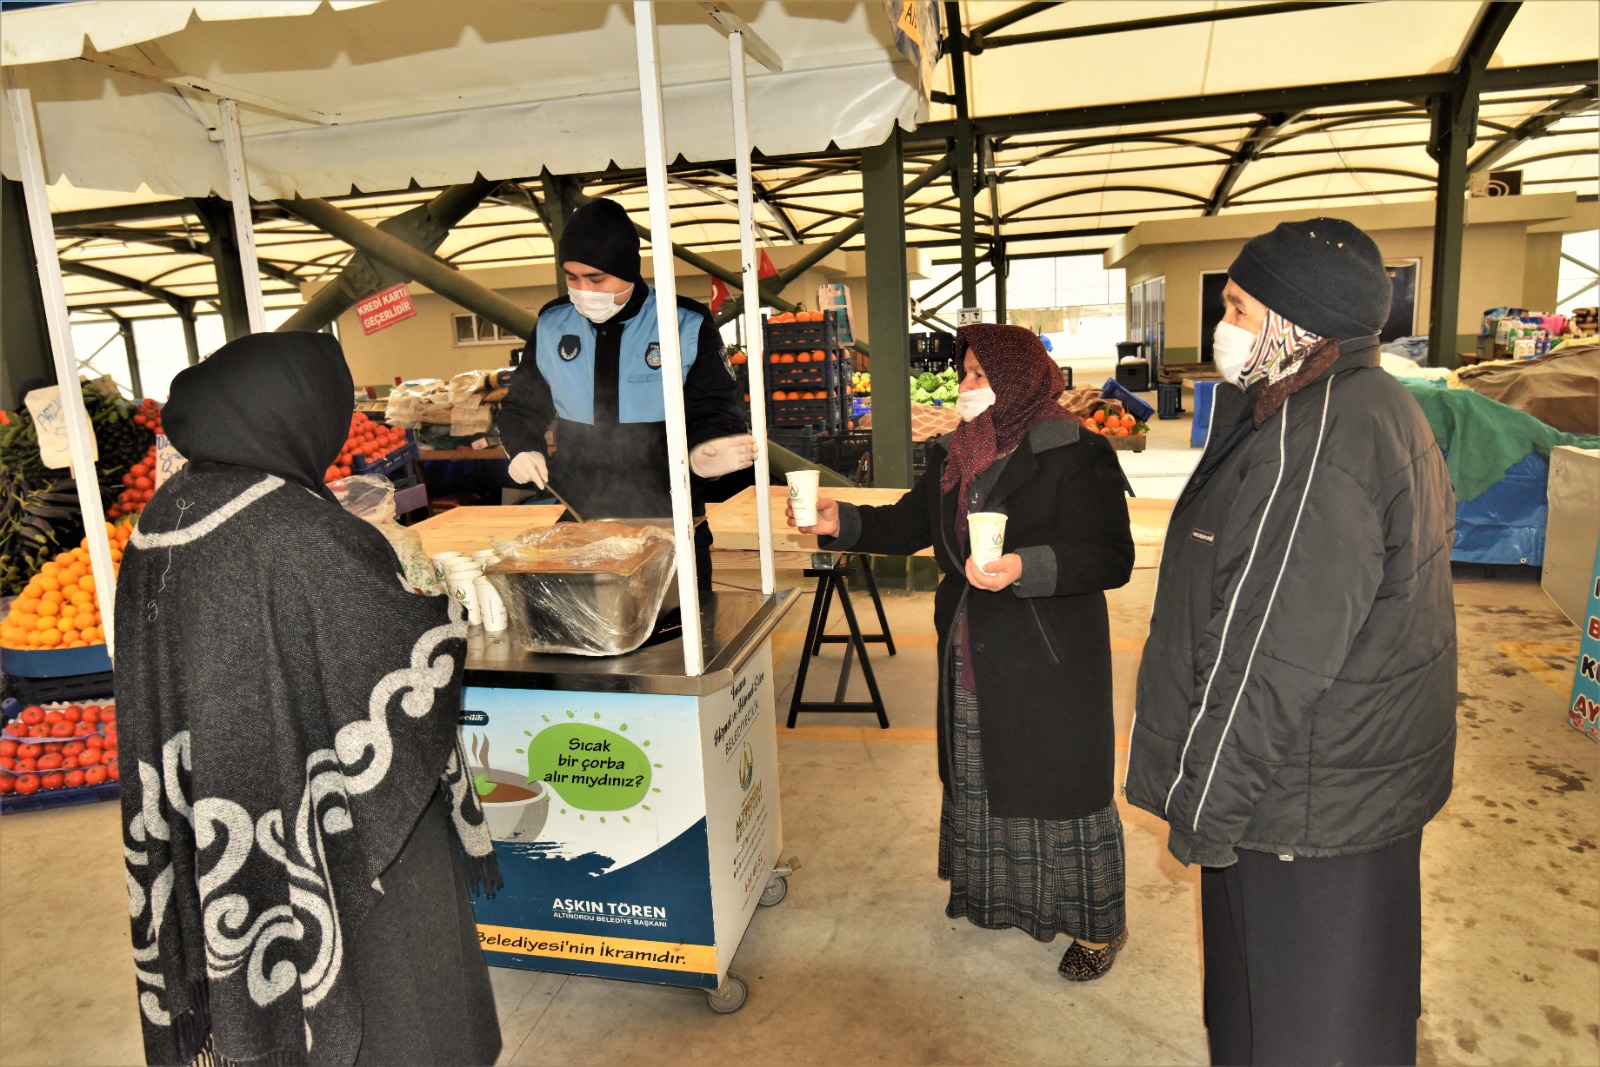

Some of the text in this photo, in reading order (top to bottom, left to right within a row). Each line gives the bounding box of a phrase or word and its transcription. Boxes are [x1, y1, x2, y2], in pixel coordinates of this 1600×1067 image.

[357, 287, 408, 316] KREDİ KARTI
[363, 301, 412, 328] GEÇERLİDİR
[569, 738, 611, 752] Sıcak
[558, 754, 625, 771] bir çorba
[543, 770, 644, 788] alır mıydınız?
[552, 898, 666, 918] AŞKIN TÖREN
[553, 912, 667, 928] ALTINORDU BELEDİYE BAŞKANI
[476, 931, 686, 965] Belediyesi'nin İkramıdır.
